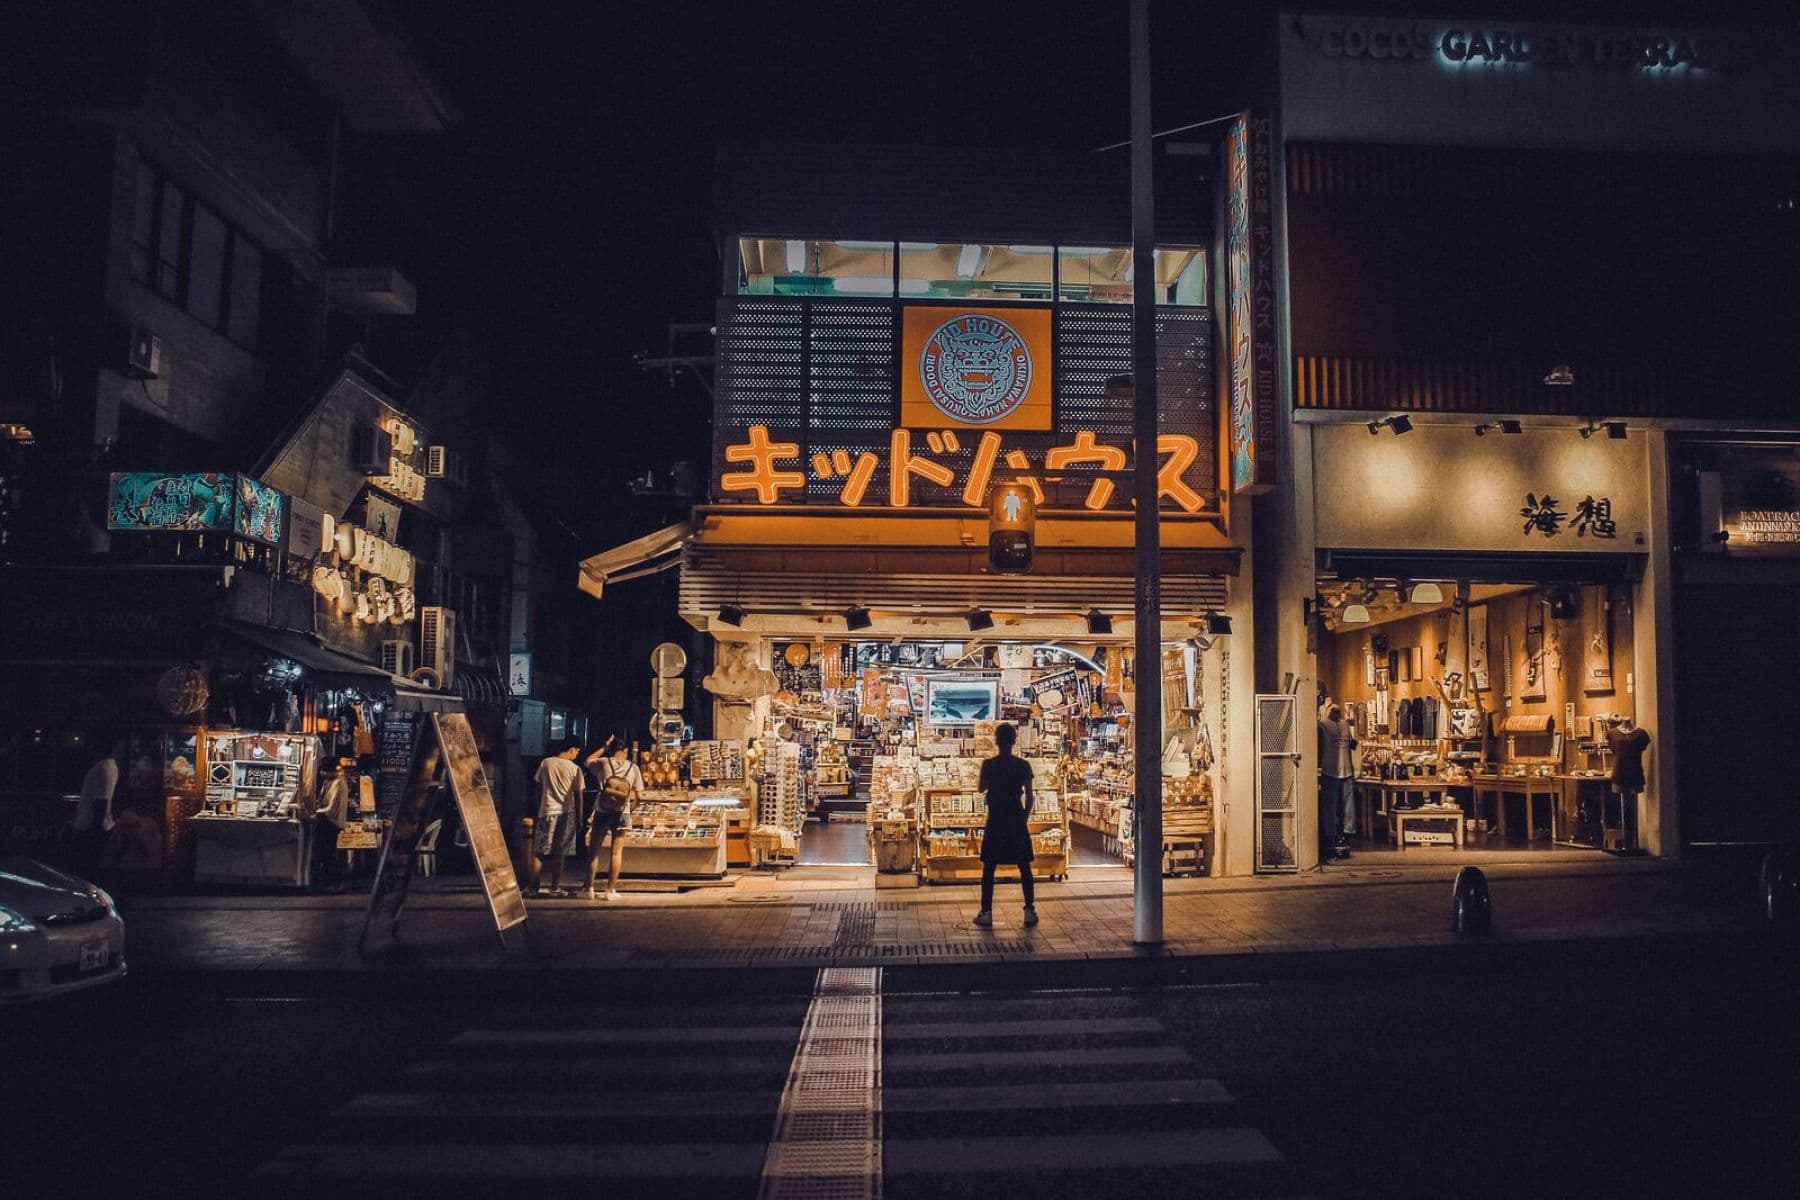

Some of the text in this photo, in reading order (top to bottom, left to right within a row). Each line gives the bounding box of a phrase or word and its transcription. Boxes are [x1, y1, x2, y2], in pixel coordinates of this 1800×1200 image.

[1440, 28, 1578, 64] GARDEN
[934, 318, 1021, 353] KID HOUSE
[926, 354, 939, 388] DOORI
[1005, 354, 1027, 403] OKINAWA
[719, 424, 1206, 513] キッドハウス
[1520, 492, 1616, 539] 海想
